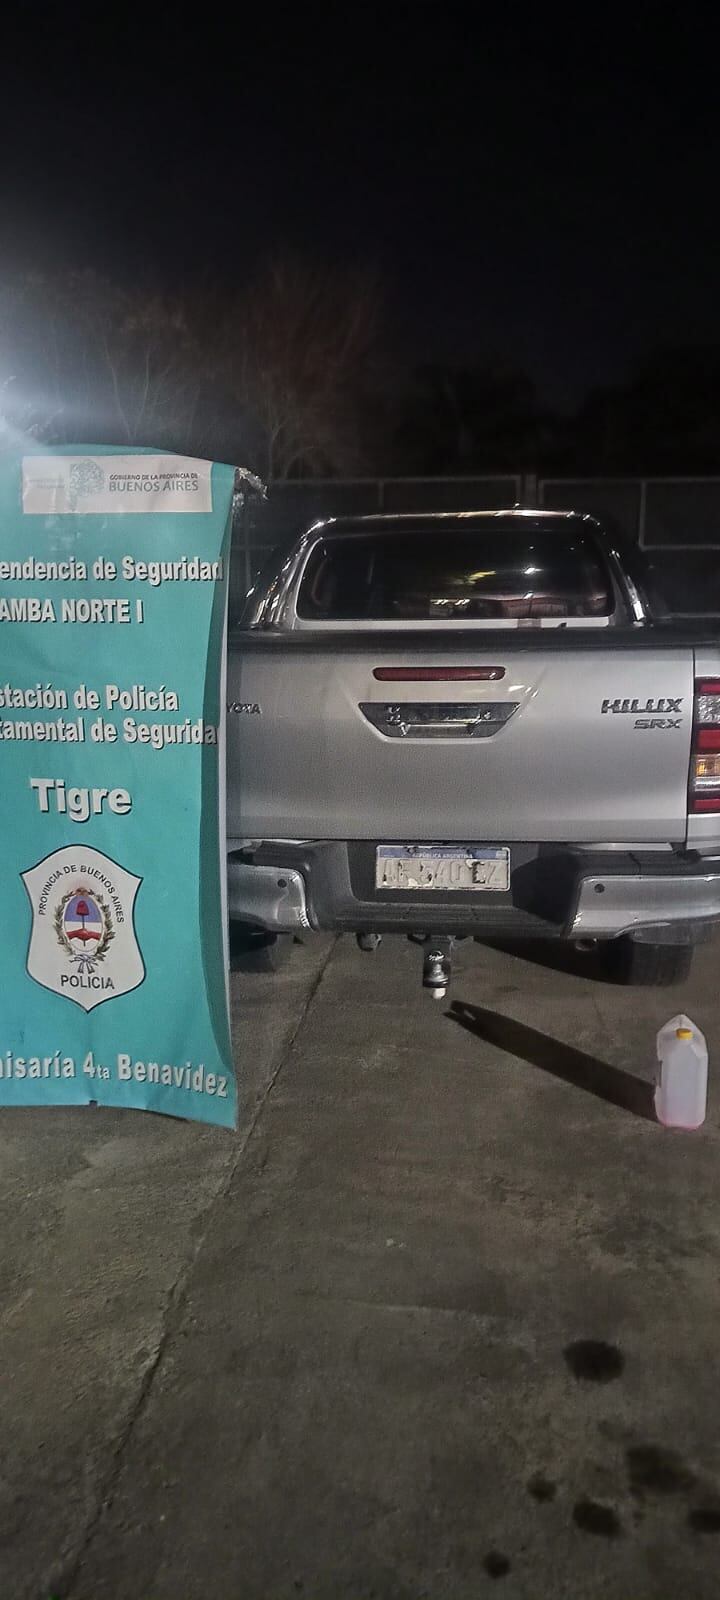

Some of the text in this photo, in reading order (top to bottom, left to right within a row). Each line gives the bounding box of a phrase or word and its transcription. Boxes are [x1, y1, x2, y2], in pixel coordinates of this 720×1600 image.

[109, 480, 199, 492] BUENOS AIRES
[93, 557, 116, 580] de
[122, 555, 223, 586] Seguridad
[0, 598, 144, 623] AMBA NORTE I
[74, 684, 100, 710] de
[106, 685, 180, 711] Policía
[601, 698, 684, 713] HILUX
[91, 717, 117, 743] de
[124, 717, 220, 749] Segurida
[633, 719, 683, 729] SRX
[30, 777, 132, 822] Tigre
[38, 864, 124, 923] PROVINCIA DE BUENOS AIRES
[60, 975, 115, 989] POLICIA
[83, 1052, 110, 1080] 4ta
[118, 1053, 228, 1098] Benavidez
